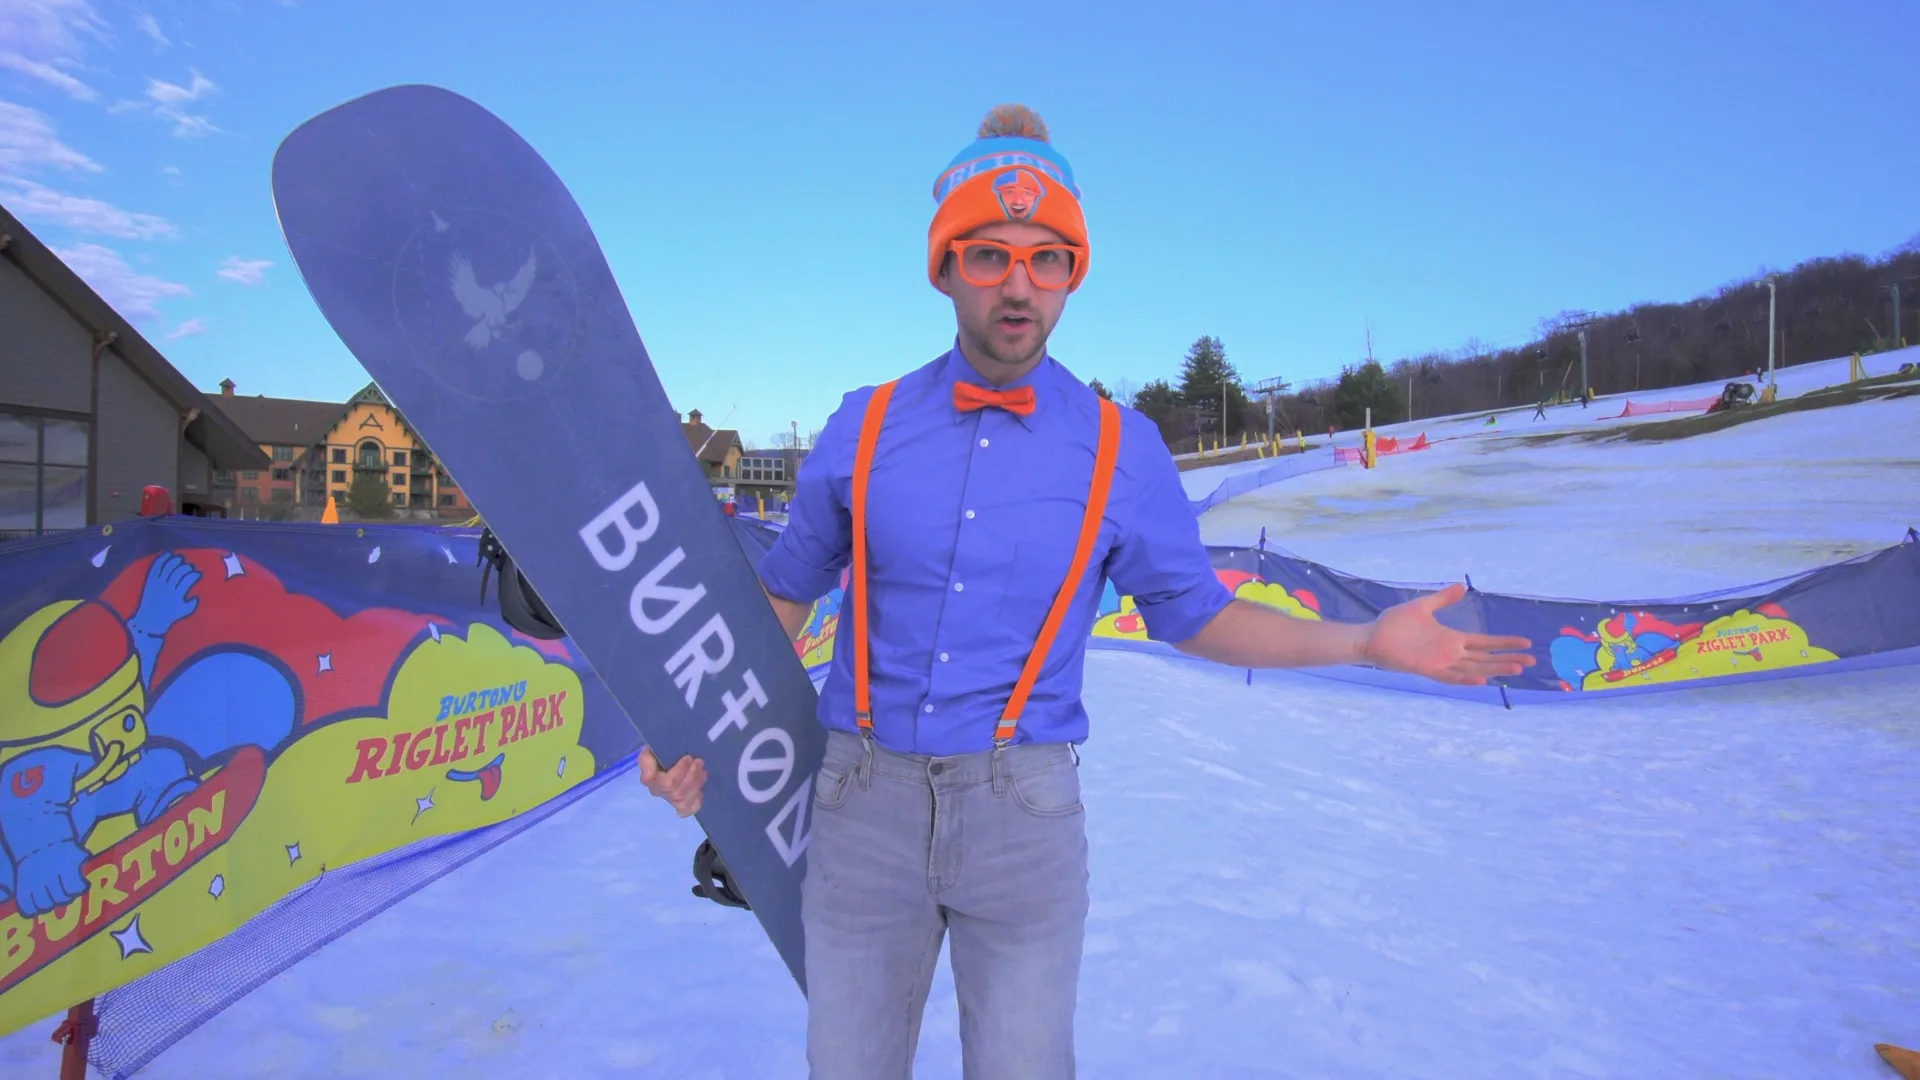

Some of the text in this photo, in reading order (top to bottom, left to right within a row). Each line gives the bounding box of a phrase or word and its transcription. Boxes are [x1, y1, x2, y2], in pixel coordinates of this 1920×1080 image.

[1696, 628, 1791, 654] RIGLET PARK
[345, 690, 567, 784] RIGLET PARK
[0, 789, 226, 980] BURTON
